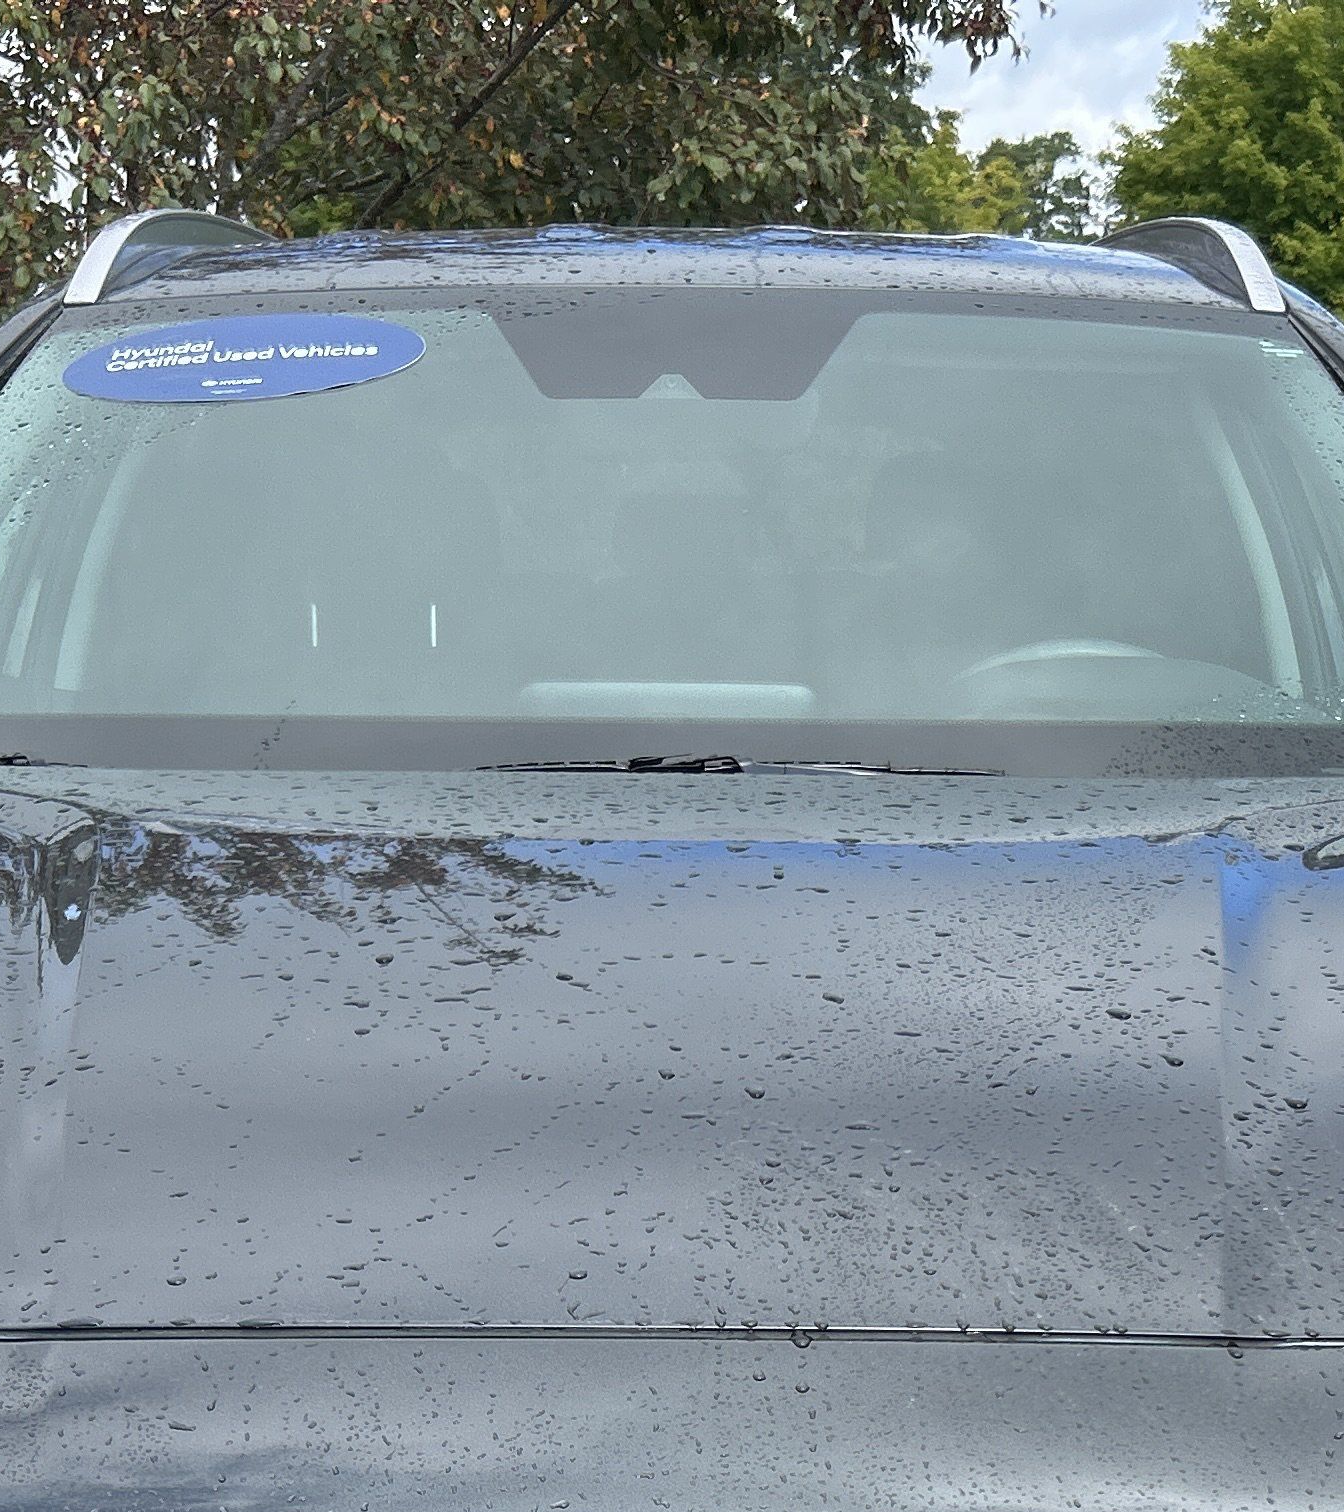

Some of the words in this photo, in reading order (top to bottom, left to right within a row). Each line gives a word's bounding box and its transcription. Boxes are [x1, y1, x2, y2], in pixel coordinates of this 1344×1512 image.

[106, 352, 209, 372] Certified
[213, 348, 274, 363] Used
[278, 345, 379, 359] Vehicles
[111, 340, 214, 361] Hyundai
